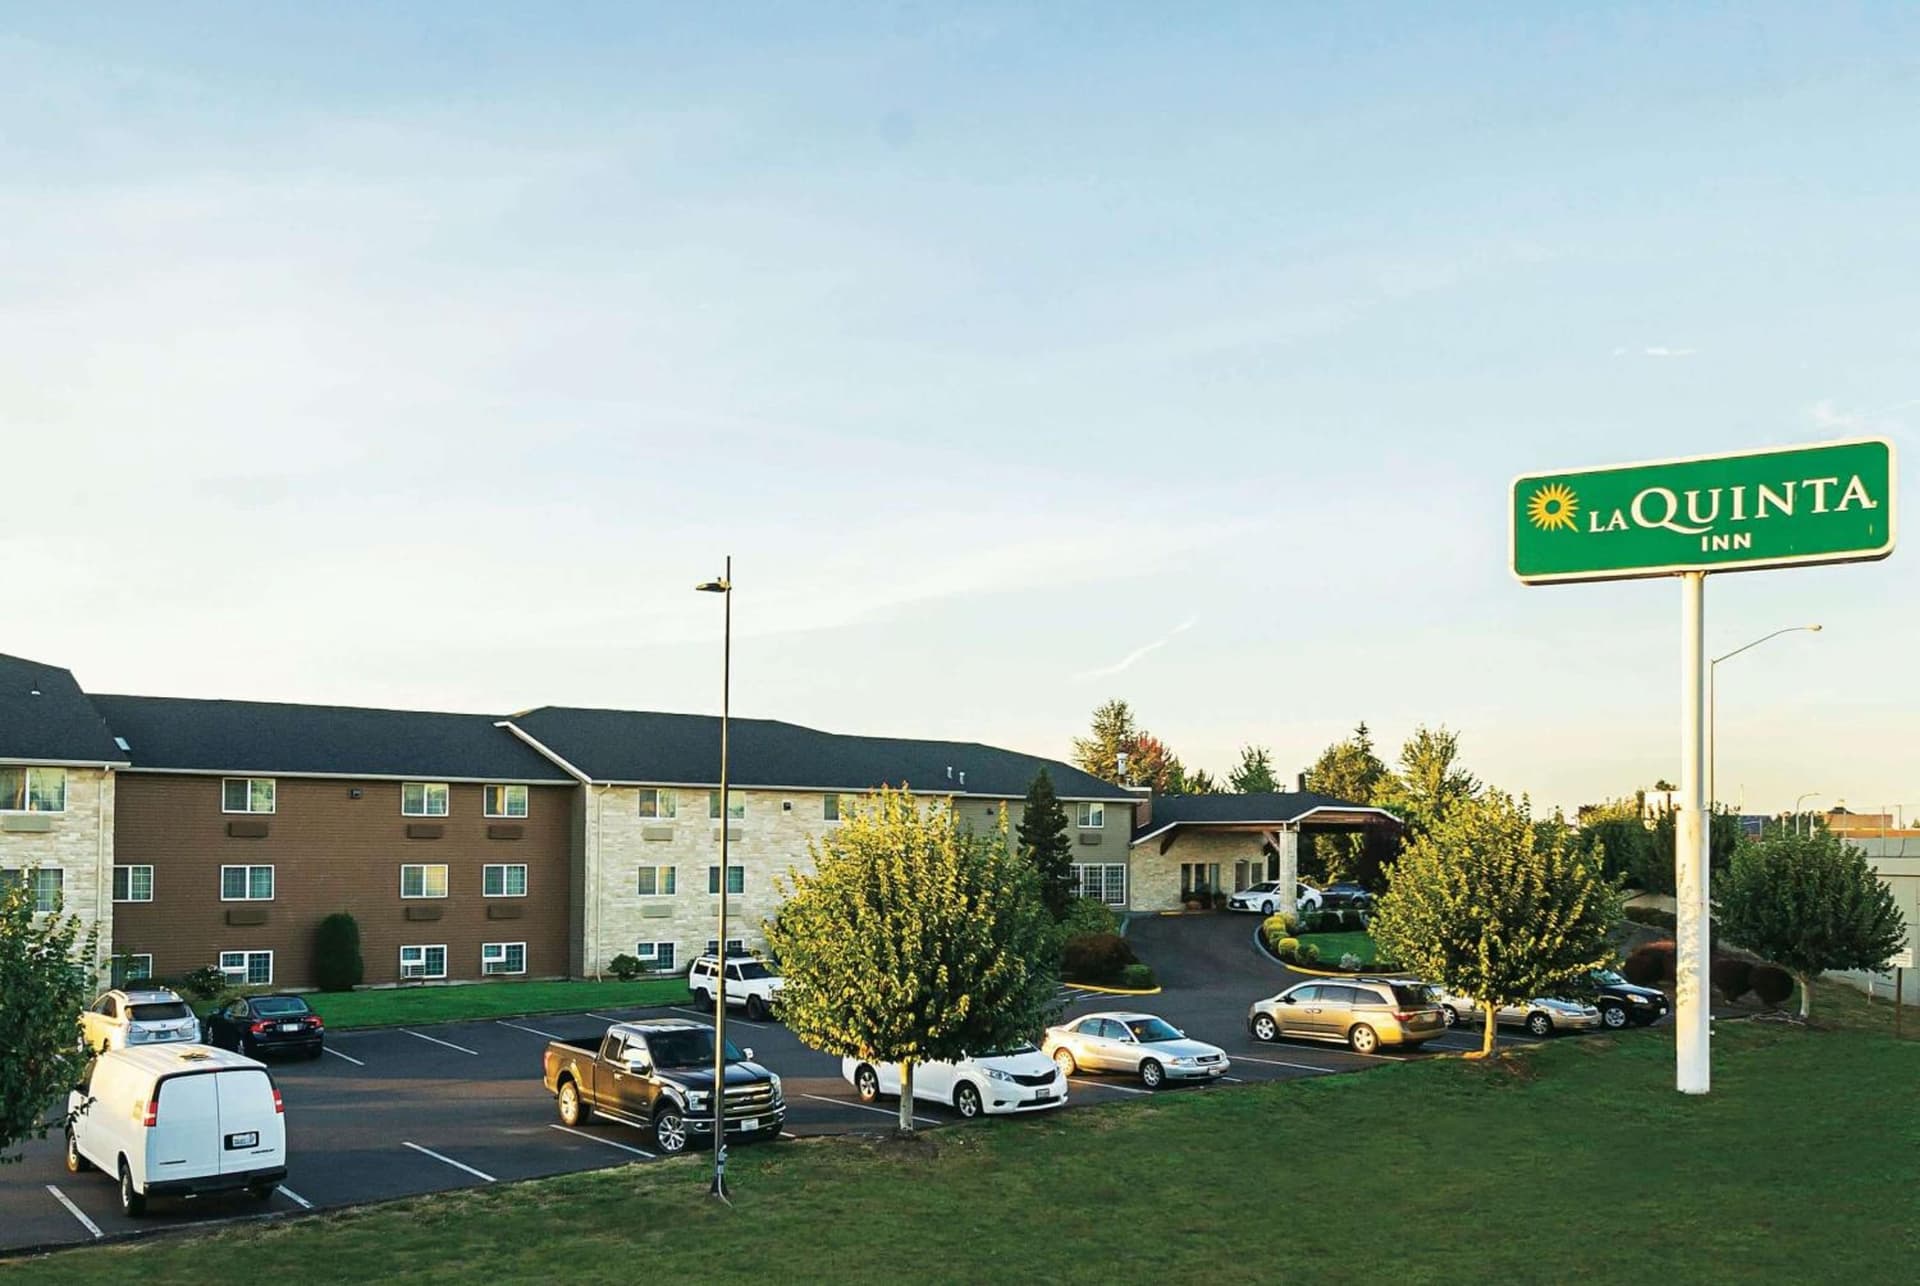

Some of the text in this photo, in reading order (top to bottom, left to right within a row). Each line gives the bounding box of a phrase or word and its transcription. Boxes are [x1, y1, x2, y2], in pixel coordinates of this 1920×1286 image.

[1588, 474, 1878, 535] LA QUINTA
[1701, 532, 1751, 552] INN
